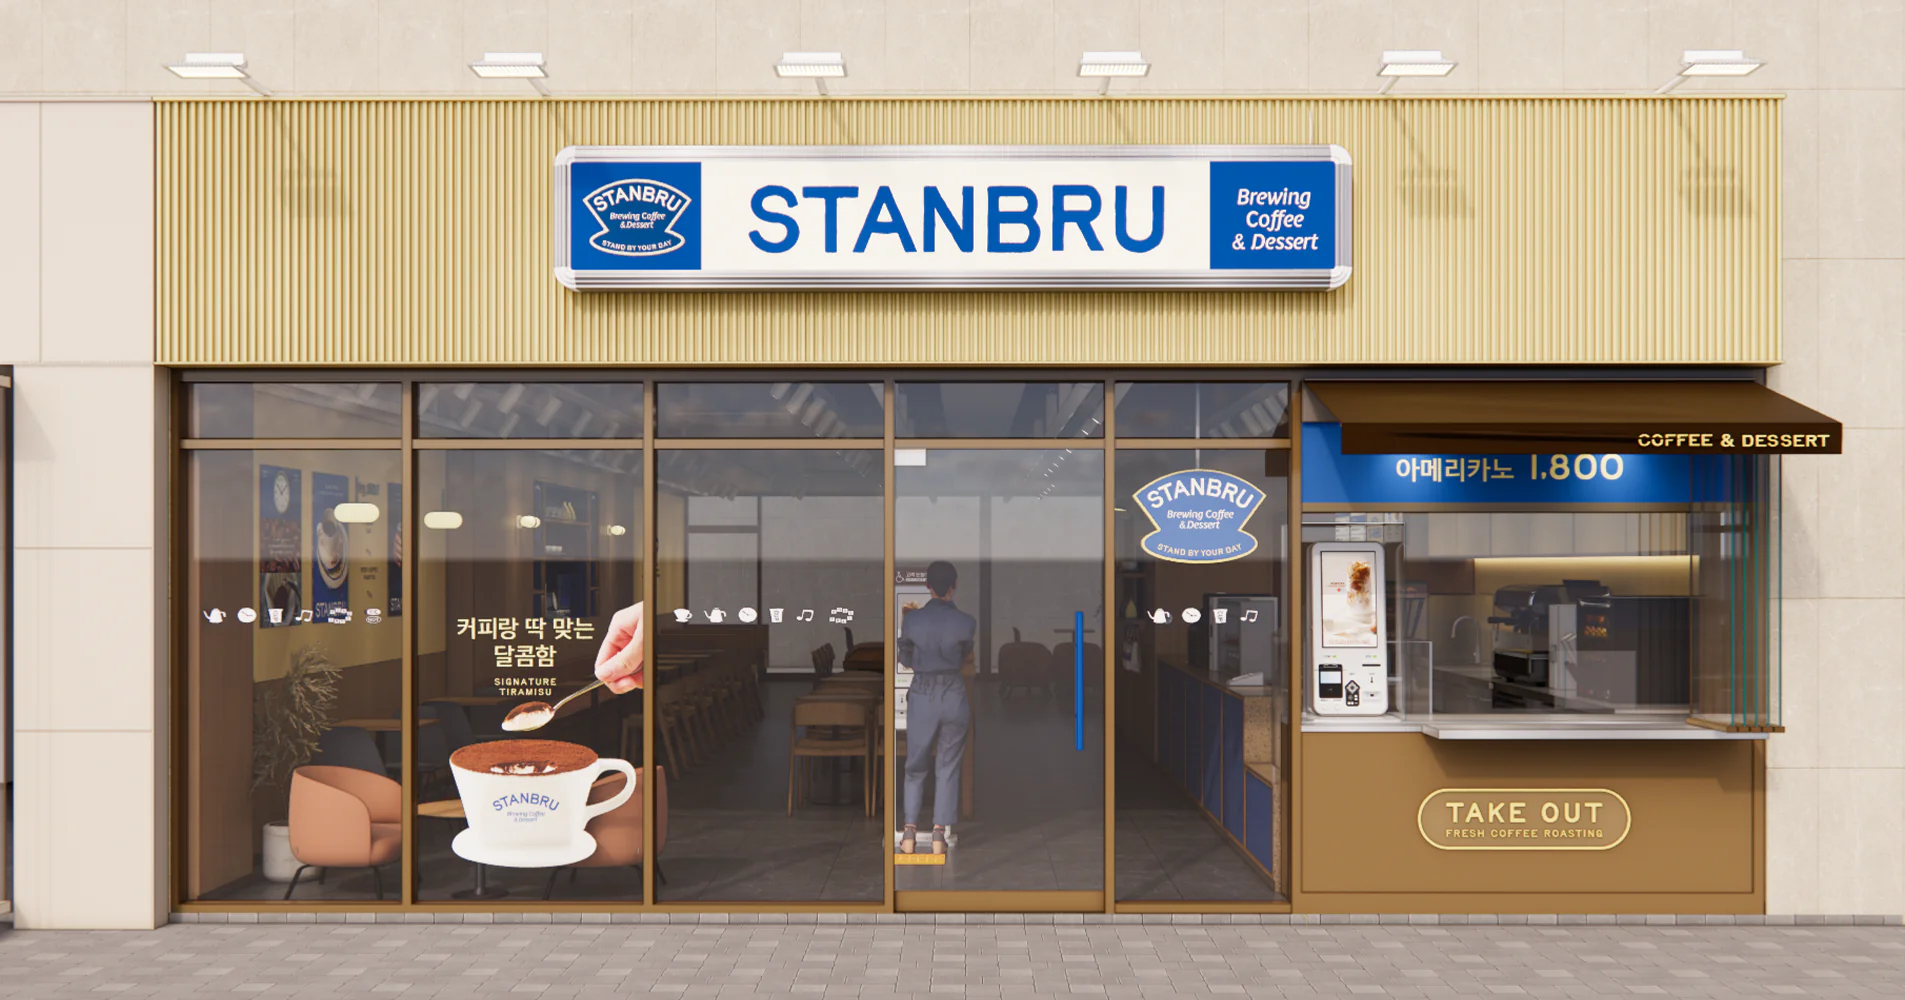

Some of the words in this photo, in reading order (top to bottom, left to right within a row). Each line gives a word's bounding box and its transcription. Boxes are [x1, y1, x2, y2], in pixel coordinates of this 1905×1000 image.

[593, 185, 682, 212] STANBRU
[1237, 187, 1311, 210] Brewing
[610, 212, 640, 221] Brewing
[641, 211, 666, 222] Coffee
[749, 184, 1165, 254] STANBRU
[1246, 210, 1304, 231] Coffee
[602, 240, 626, 251] STAND
[637, 243, 657, 251] YOUR
[658, 239, 672, 249] DAY
[1232, 234, 1245, 250] &
[1251, 233, 1318, 250] Dessert
[1638, 433, 1713, 447] COFFEE
[1720, 433, 1735, 448] &
[1742, 434, 1830, 448] DESSERT
[1395, 457, 1515, 483] 아메리카노
[1531, 453, 1624, 481] 1,800
[1147, 477, 1255, 509] STANBRU
[1167, 509, 1203, 520] Brewing
[1205, 509, 1234, 520] Coffee
[1157, 543, 1186, 556] STAND
[1188, 549, 1199, 557] BY
[1201, 548, 1224, 557] YOUR
[1225, 543, 1242, 555] DAY
[457, 617, 519, 640] 커피랑
[525, 617, 547, 640] 딱
[553, 617, 595, 640] 맞는
[494, 644, 557, 668] 달콤함
[494, 677, 557, 686] SIGNATURE
[499, 688, 552, 696] TIRAMISU
[492, 792, 560, 811] STANBRU
[1445, 802, 1526, 823] TAKE
[1541, 802, 1603, 823] OUT
[1446, 829, 1485, 838] FRESH
[1491, 829, 1538, 838] COFFEE
[1544, 829, 1604, 838] ROASTING
